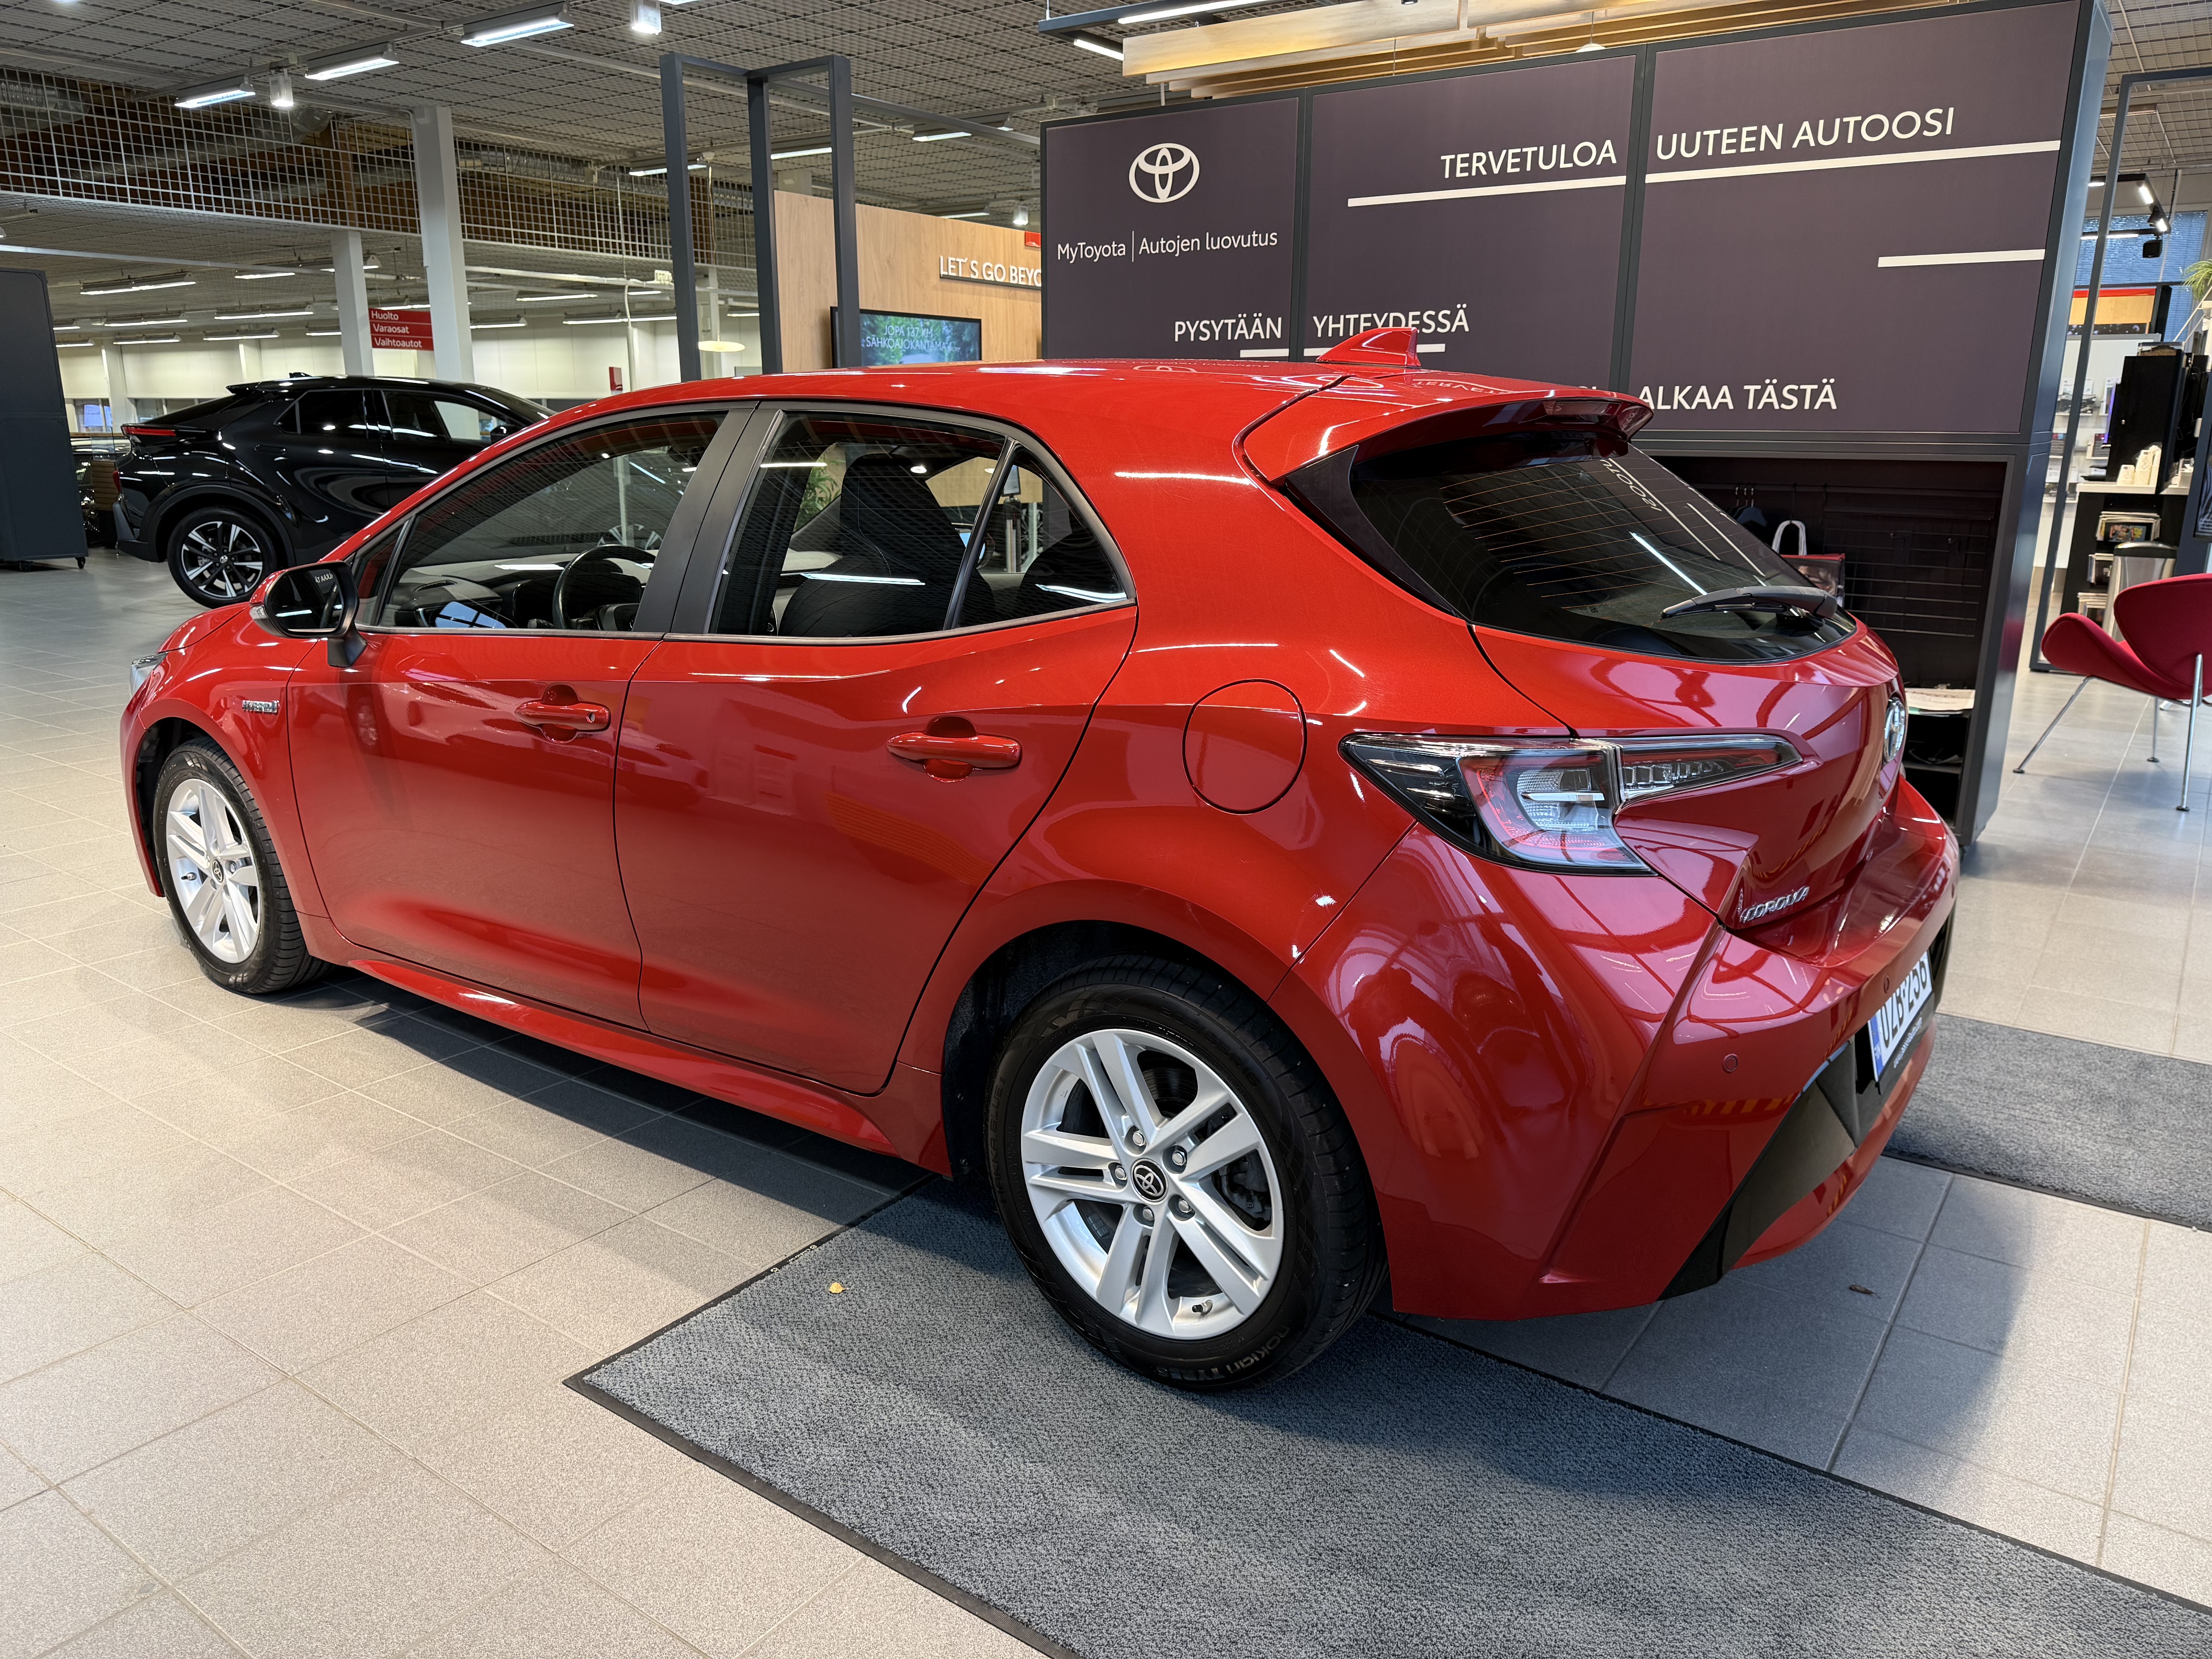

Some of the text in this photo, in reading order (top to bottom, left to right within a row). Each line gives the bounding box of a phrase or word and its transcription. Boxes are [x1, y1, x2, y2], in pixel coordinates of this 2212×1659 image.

[1441, 107, 1954, 179] TERVETULOA UUTEEN AUTOOSI
[1058, 230, 1278, 263] MyToyota Autojen luovutus
[982, 262, 1006, 282] GO
[371, 310, 399, 321] Huolto
[1175, 304, 1470, 342] PYSYTÄÄN YHTEYDESSÄ
[373, 323, 410, 334] Varaosat
[883, 325, 905, 337] JOPA
[374, 337, 423, 348] Vaihtoautot
[1638, 378, 1837, 410] ALKAA TÄSTÄ
